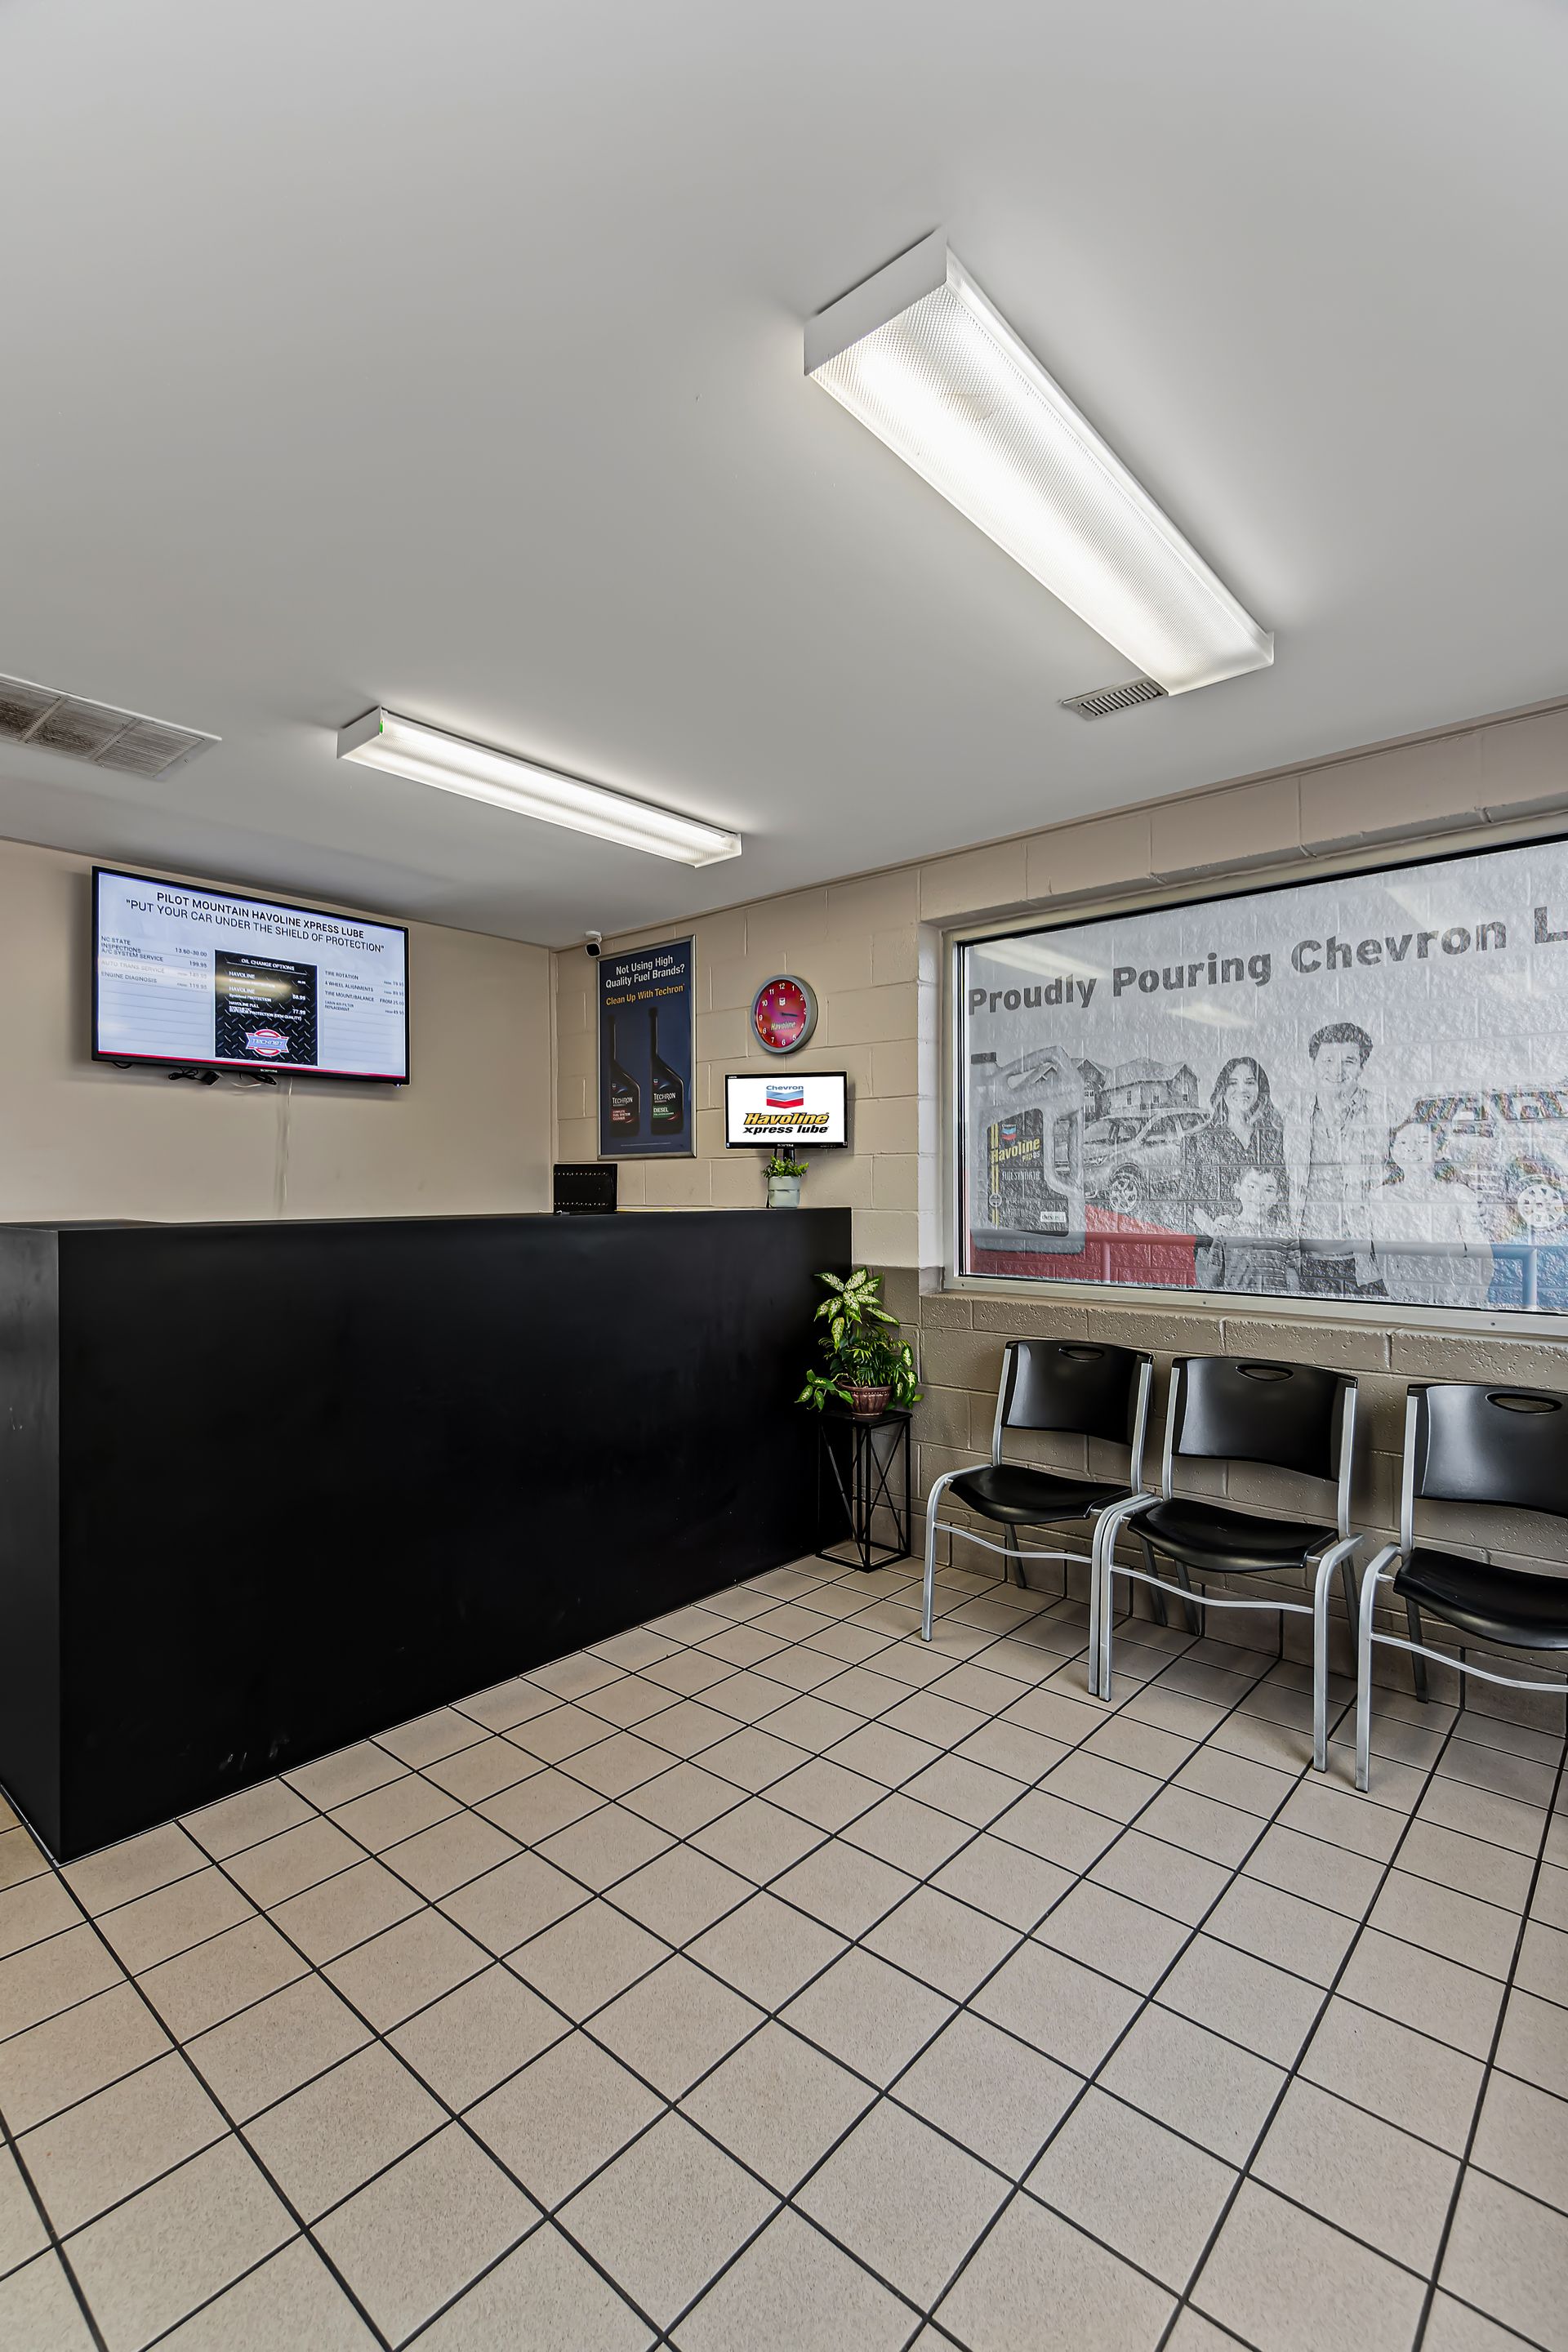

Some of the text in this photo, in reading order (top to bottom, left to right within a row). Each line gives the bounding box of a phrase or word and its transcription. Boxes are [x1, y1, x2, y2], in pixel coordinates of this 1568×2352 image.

[157, 892, 364, 939] PILOT MOUNTAIN HAVOLINE XPRESS LUBE
[157, 905, 188, 919] YOUR
[191, 911, 212, 923] CAR
[216, 916, 250, 929] UNDER
[253, 922, 273, 934] THE
[275, 926, 309, 940] SHIELD
[311, 933, 323, 942] OF
[111, 938, 131, 946] STATE
[101, 942, 141, 954] INSPECTIONS
[114, 950, 139, 958] SYSTEM
[139, 953, 163, 962] SERVICE
[119, 962, 139, 970] TRANS
[140, 965, 165, 973] SERVICE
[251, 960, 272, 969] CHANGE
[273, 963, 295, 971] OPTIONS
[616, 955, 673, 976] Not Using High
[969, 973, 1098, 1016] Proudly
[1113, 952, 1272, 997] Pouring
[1290, 920, 1507, 974] Chevron
[101, 972, 123, 980] ENGINE
[125, 975, 157, 983] DIAGNOSIS
[229, 970, 256, 980] HAVOLINE
[335, 972, 359, 980] ROTATION
[605, 964, 685, 988] Quality Fuel Brands?
[345, 983, 374, 992] ALIGNMENTS
[606, 983, 684, 1006] Clean Up With Techron
[771, 1021, 796, 1031] Havoline
[653, 1093, 676, 1101] TECHRON
[743, 1112, 830, 1125] Havoline
[743, 1125, 828, 1135] xpress lube
[990, 1137, 1040, 1165] Havoline
